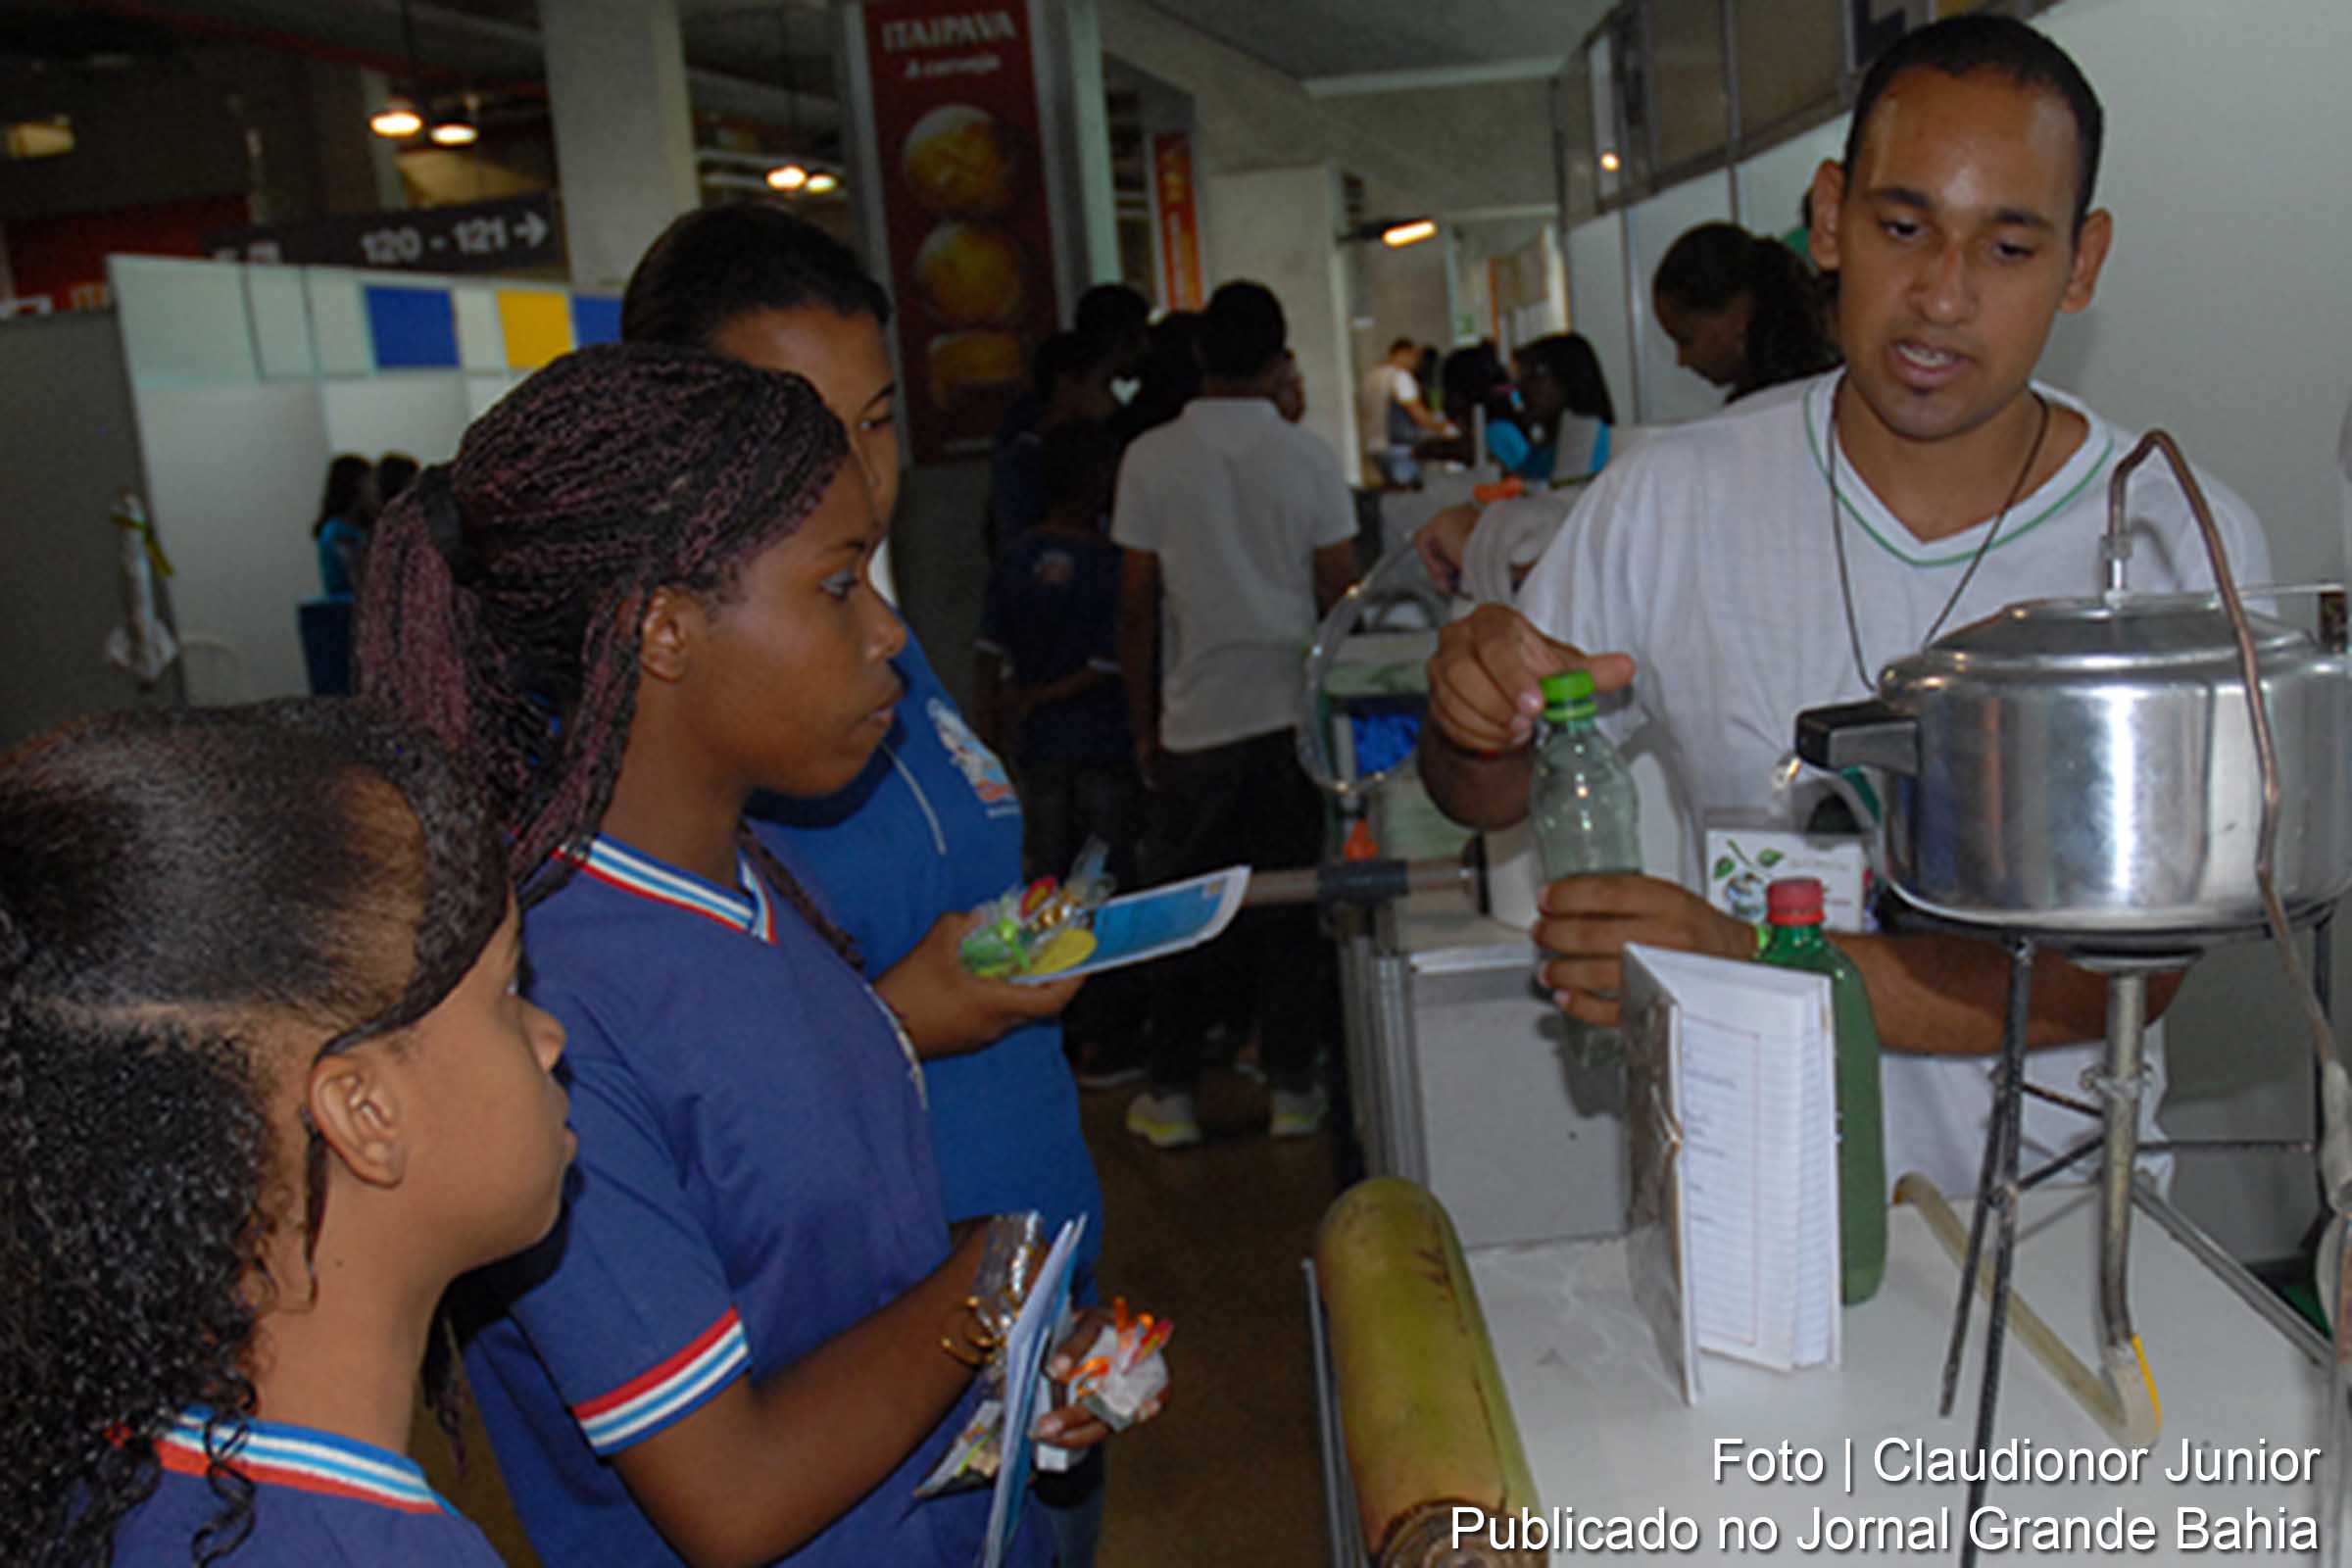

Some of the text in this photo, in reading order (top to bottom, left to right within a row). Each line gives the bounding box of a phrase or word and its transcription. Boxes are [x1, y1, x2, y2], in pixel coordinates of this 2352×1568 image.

[883, 11, 1017, 51] ITAIPAVA
[362, 226, 422, 265] 120
[454, 213, 509, 256] 121
